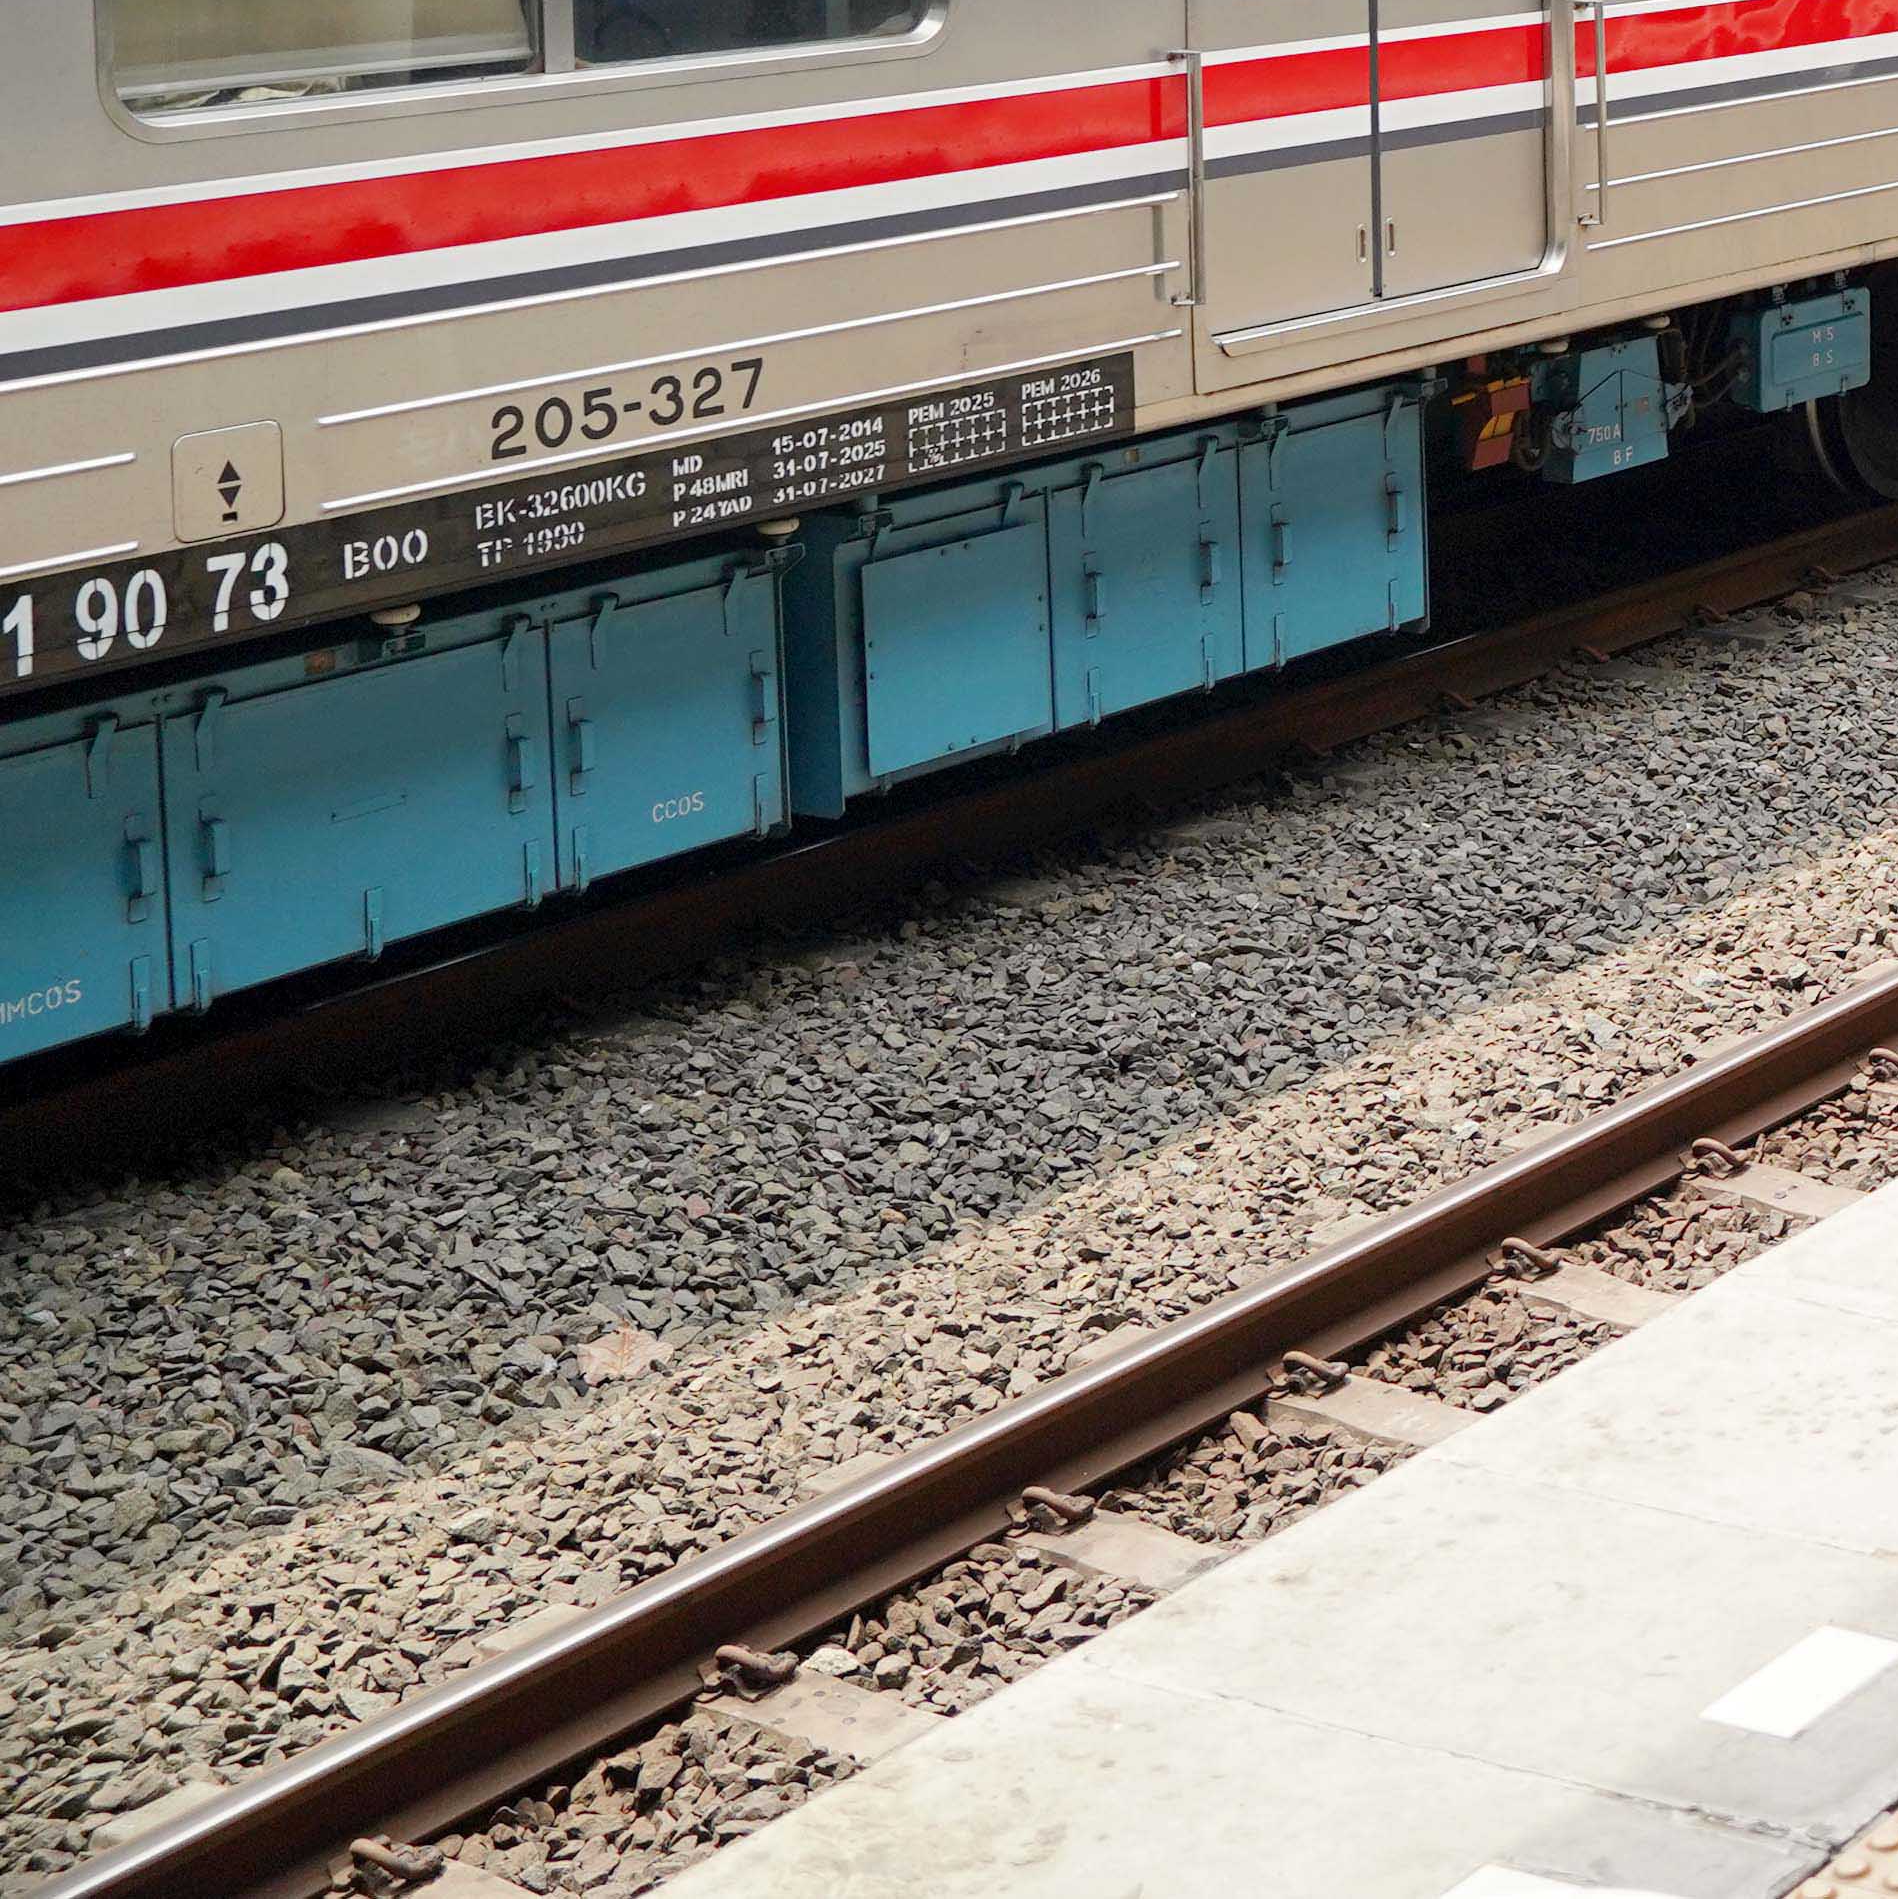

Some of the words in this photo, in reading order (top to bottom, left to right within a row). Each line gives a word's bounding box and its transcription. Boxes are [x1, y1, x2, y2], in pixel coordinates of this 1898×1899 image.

[1021, 380, 1055, 400] PEM
[1060, 368, 1101, 392] 2026
[490, 357, 763, 460] 205-327
[908, 404, 945, 425] PEM
[950, 391, 995, 417] 2025
[772, 416, 883, 456] 15-07-2014
[1588, 423, 1622, 445] 750A
[672, 454, 704, 477] MD
[772, 439, 886, 480] 31-07-2025
[475, 470, 646, 531] BK-32600KG
[673, 483, 685, 501] P
[772, 464, 885, 504] 31-07-2027
[673, 510, 686, 527] P
[690, 496, 753, 524] 24YAD
[3, 594, 34, 678] 1
[75, 569, 168, 661] 90
[206, 542, 289, 633] 73
[652, 791, 704, 823] CCOS
